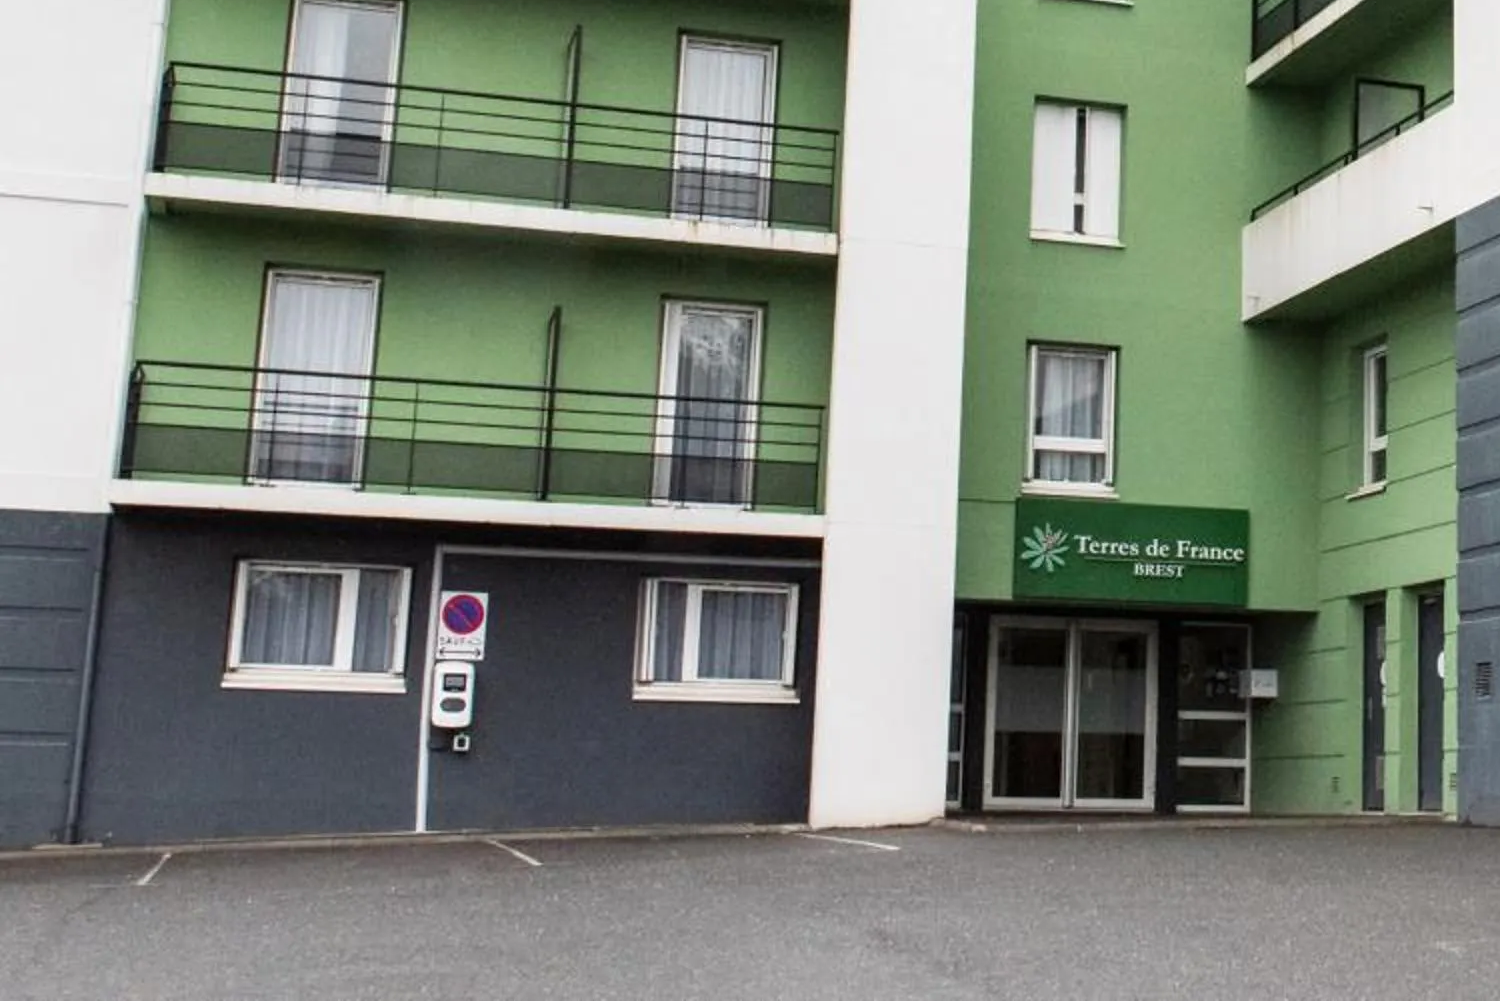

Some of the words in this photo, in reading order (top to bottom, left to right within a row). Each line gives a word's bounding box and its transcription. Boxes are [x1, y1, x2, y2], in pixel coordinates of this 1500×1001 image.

[1074, 535, 1139, 556] Terres
[1145, 538, 1170, 557] de
[1175, 540, 1245, 561] France
[1133, 563, 1185, 578] BREST
